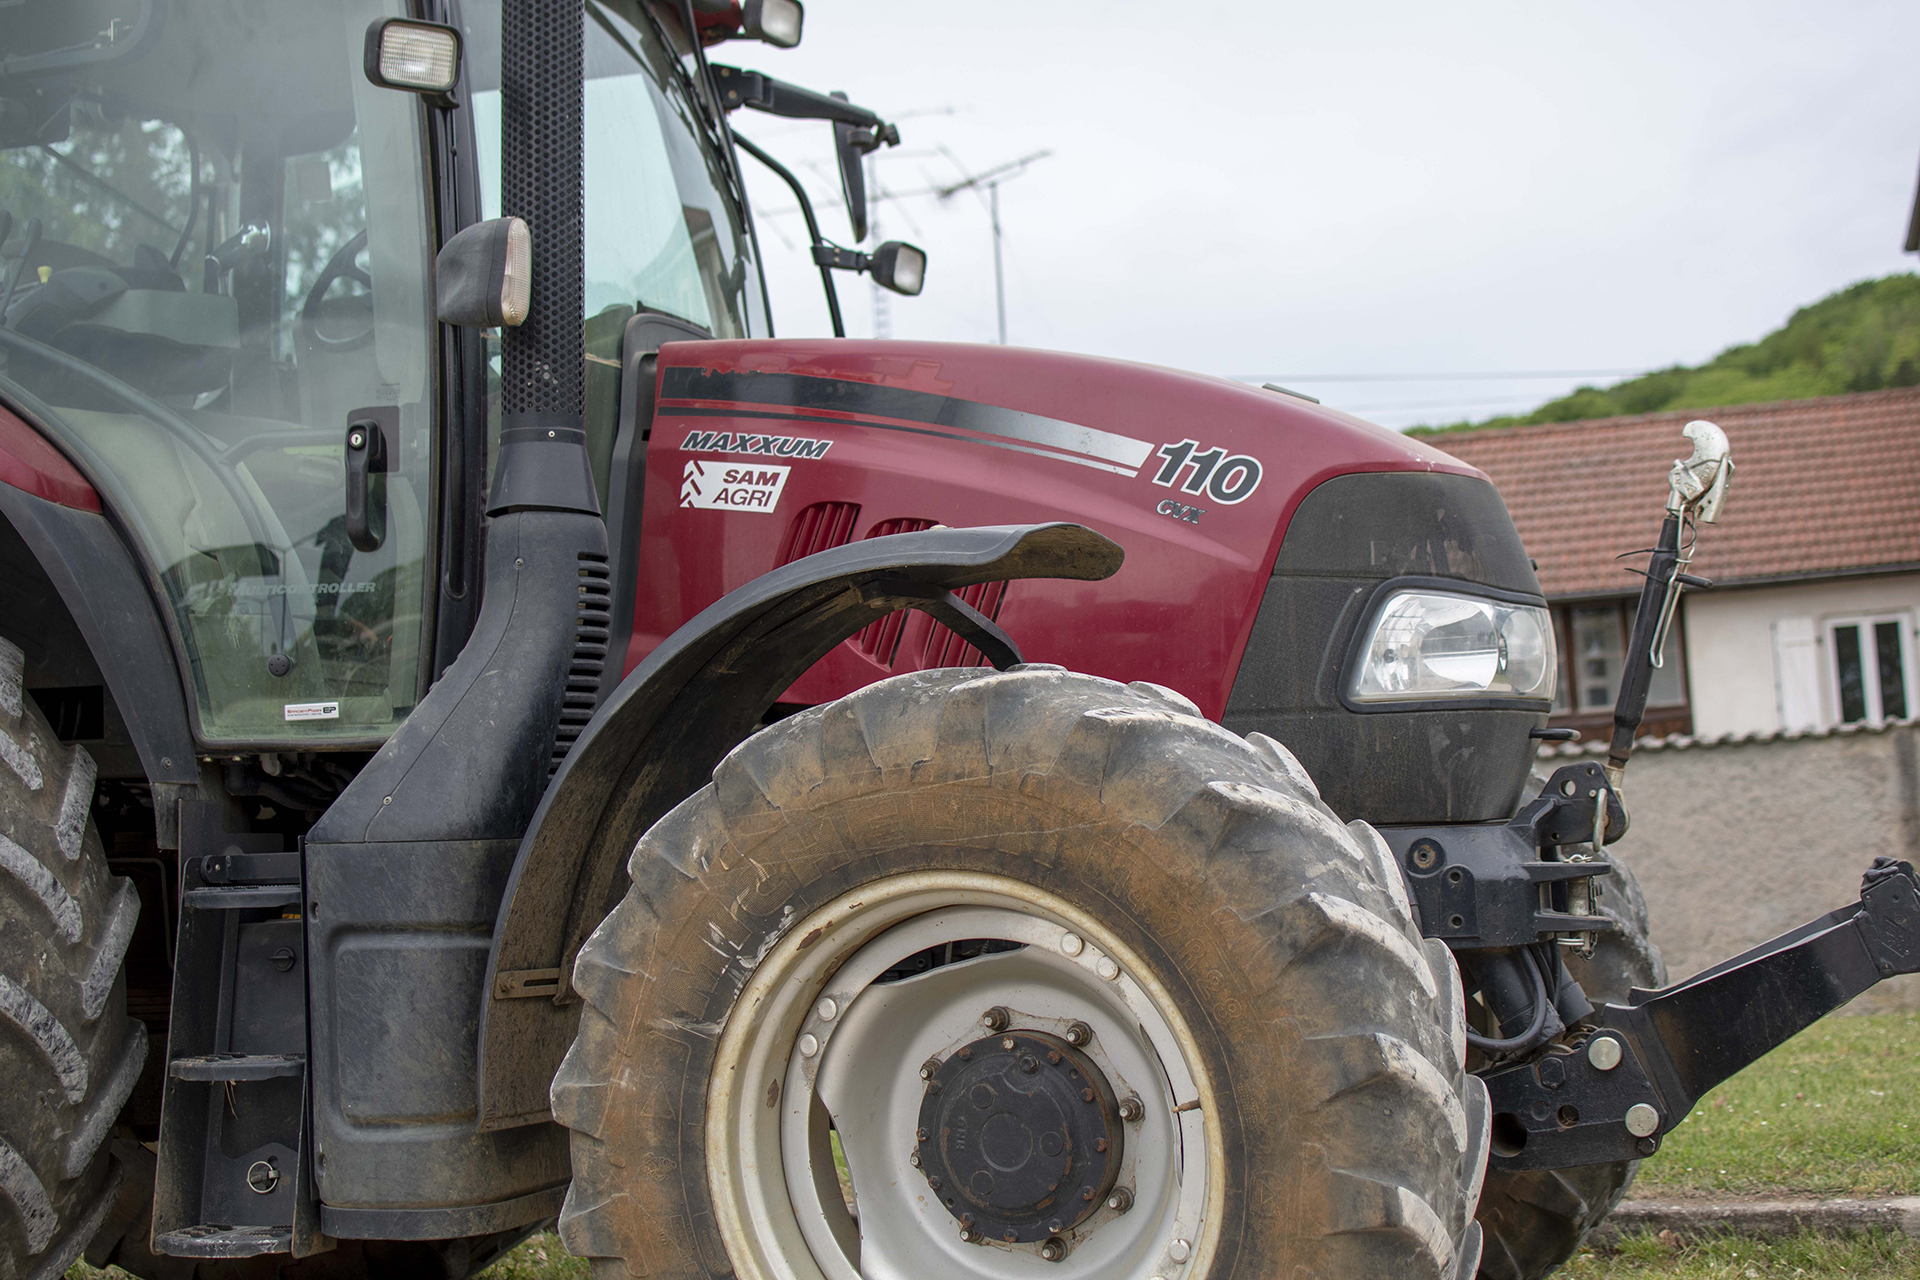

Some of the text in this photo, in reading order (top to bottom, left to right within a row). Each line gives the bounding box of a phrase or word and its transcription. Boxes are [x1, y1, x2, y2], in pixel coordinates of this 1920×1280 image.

[680, 430, 834, 460] MAXXUM
[723, 469, 780, 487] SAM
[1152, 438, 1263, 505] 110
[712, 488, 772, 507] AGRI
[1156, 499, 1206, 524] CVX
